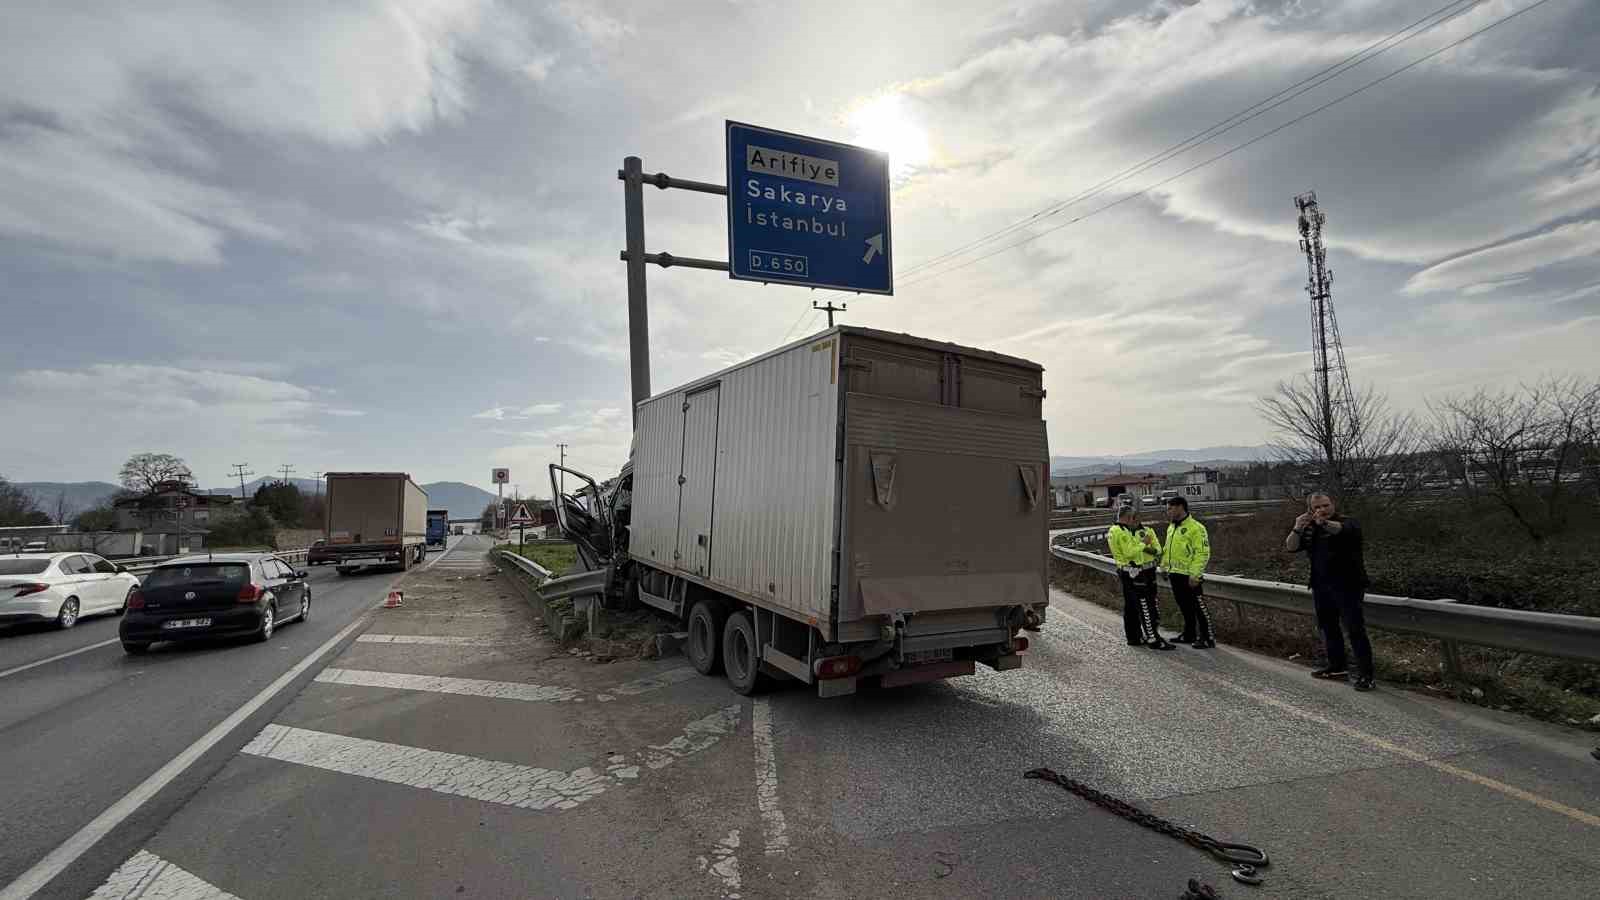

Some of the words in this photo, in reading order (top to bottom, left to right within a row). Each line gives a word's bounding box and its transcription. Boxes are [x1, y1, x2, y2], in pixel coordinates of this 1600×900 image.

[750, 149, 836, 180] Arifiye
[747, 179, 848, 213] Sakarya
[747, 202, 846, 237] İstanbul
